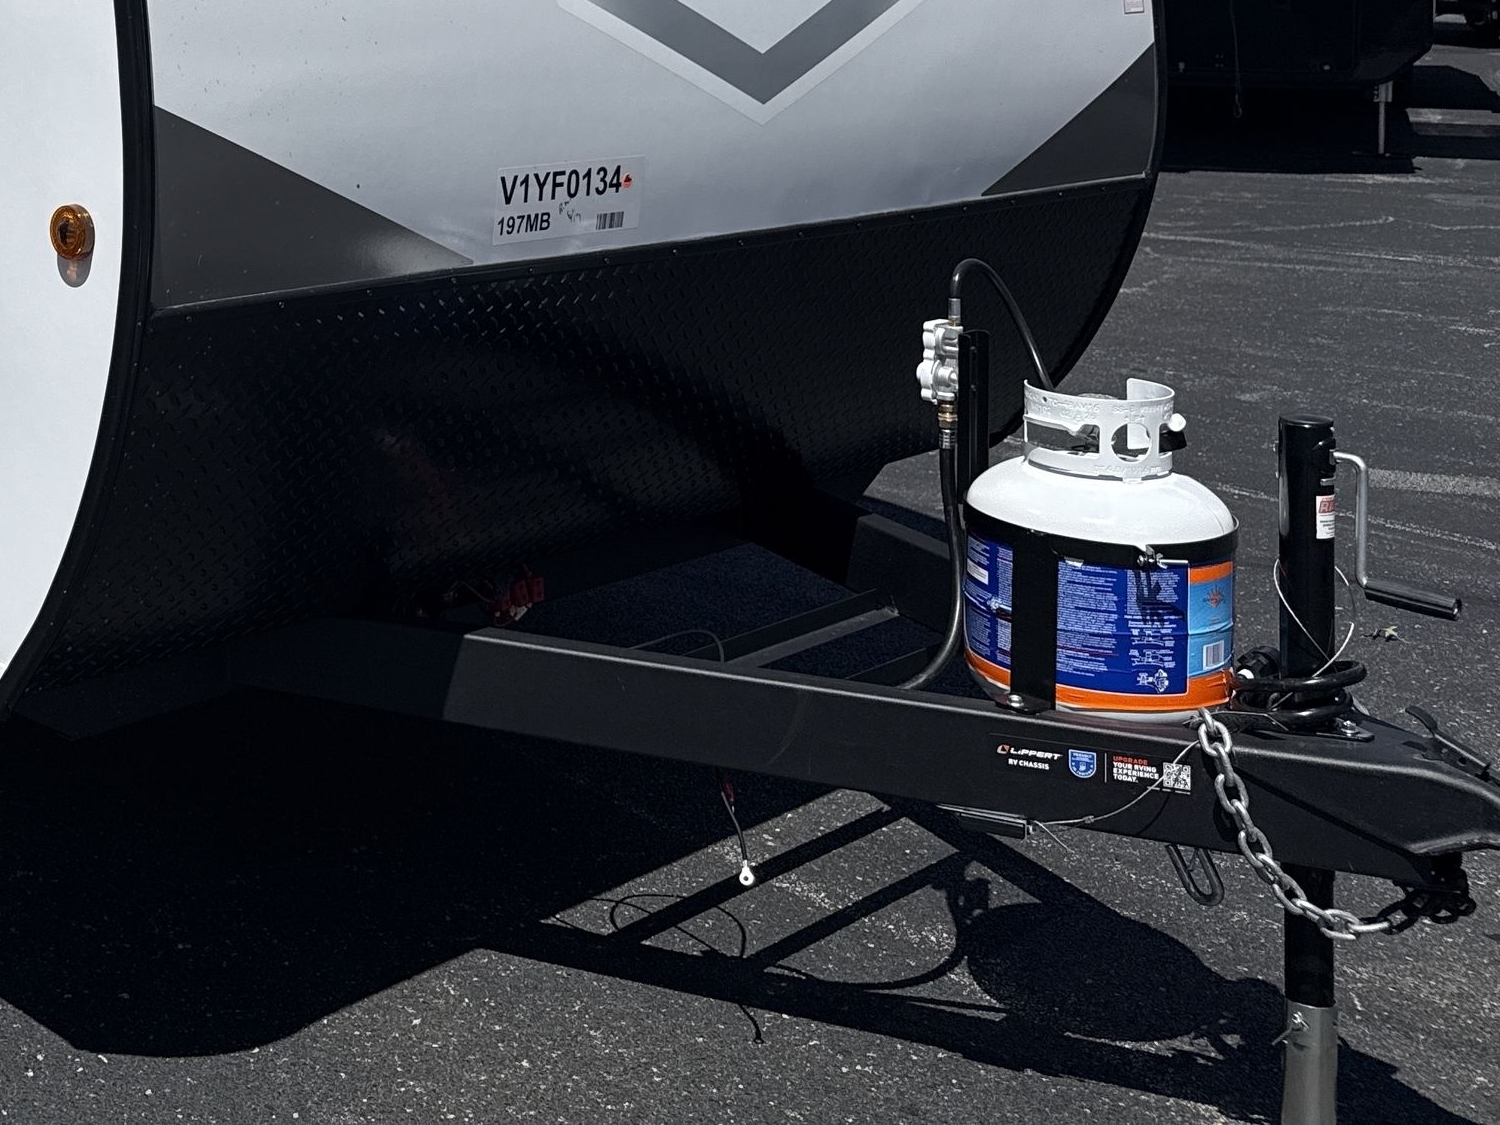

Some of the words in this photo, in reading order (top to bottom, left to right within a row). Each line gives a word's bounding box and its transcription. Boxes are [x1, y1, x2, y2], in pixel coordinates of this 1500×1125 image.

[500, 164, 622, 205] V1YF0134
[497, 211, 551, 236] 197MB
[1008, 758, 1018, 766] RV
[1019, 759, 1050, 770] CHASSIS
[1113, 756, 1148, 765] UPGRADE
[1113, 762, 1133, 770] YOUR
[1134, 764, 1157, 773] RVING
[1113, 767, 1159, 780] EXPERIENCE
